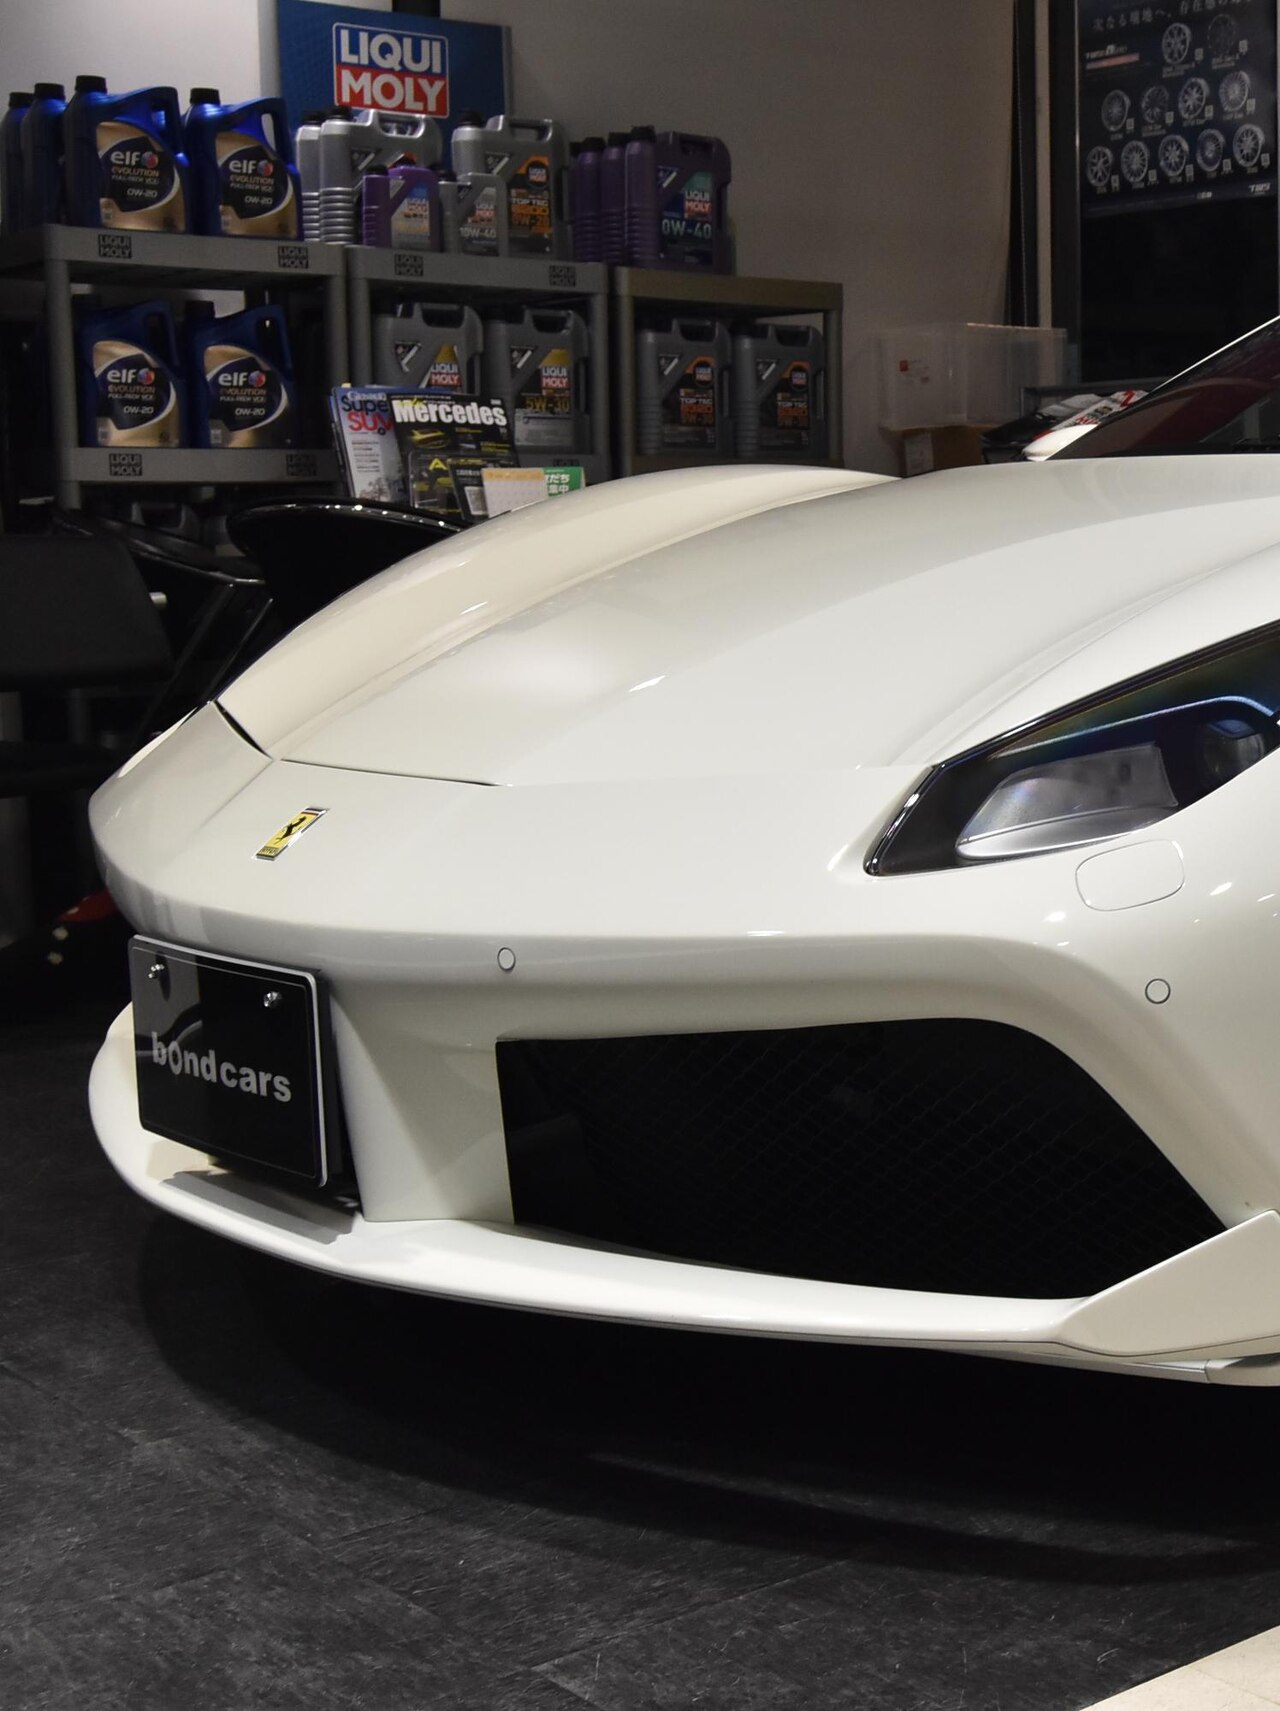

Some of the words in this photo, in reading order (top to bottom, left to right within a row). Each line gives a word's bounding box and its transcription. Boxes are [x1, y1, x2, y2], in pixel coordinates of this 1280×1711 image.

[340, 29, 441, 73] LIQUI
[341, 69, 446, 112] MOLY
[110, 151, 141, 165] elf
[229, 159, 257, 174] elf
[111, 167, 160, 178] EVOLUTION
[229, 175, 274, 185] EVOLUTION
[126, 187, 158, 198] 0W-20
[685, 190, 710, 201] LIQUI
[244, 195, 273, 205] 0W-20
[685, 200, 712, 212] MOLY
[662, 219, 711, 239] 0W-40
[100, 236, 131, 247] LIQUI
[100, 246, 132, 257] MOLY
[280, 247, 307, 257] LIQUI
[280, 257, 309, 268] MOLY
[431, 363, 458, 374] LIQUI
[542, 367, 567, 377] LIQUI
[107, 368, 137, 384] elf
[218, 372, 249, 387] elf
[431, 373, 460, 384] MOLY
[542, 377, 568, 388] MOLY
[108, 384, 155, 394] EVOLUTION
[123, 405, 154, 414] 0W-20
[341, 395, 389, 415] Supe
[526, 397, 570, 412] 5W-30
[235, 407, 266, 416] 0W-20
[391, 398, 508, 426] Mercedes
[110, 454, 141, 464] LIQUI
[110, 464, 142, 475] MOLY
[152, 1031, 292, 1103] bondcars
